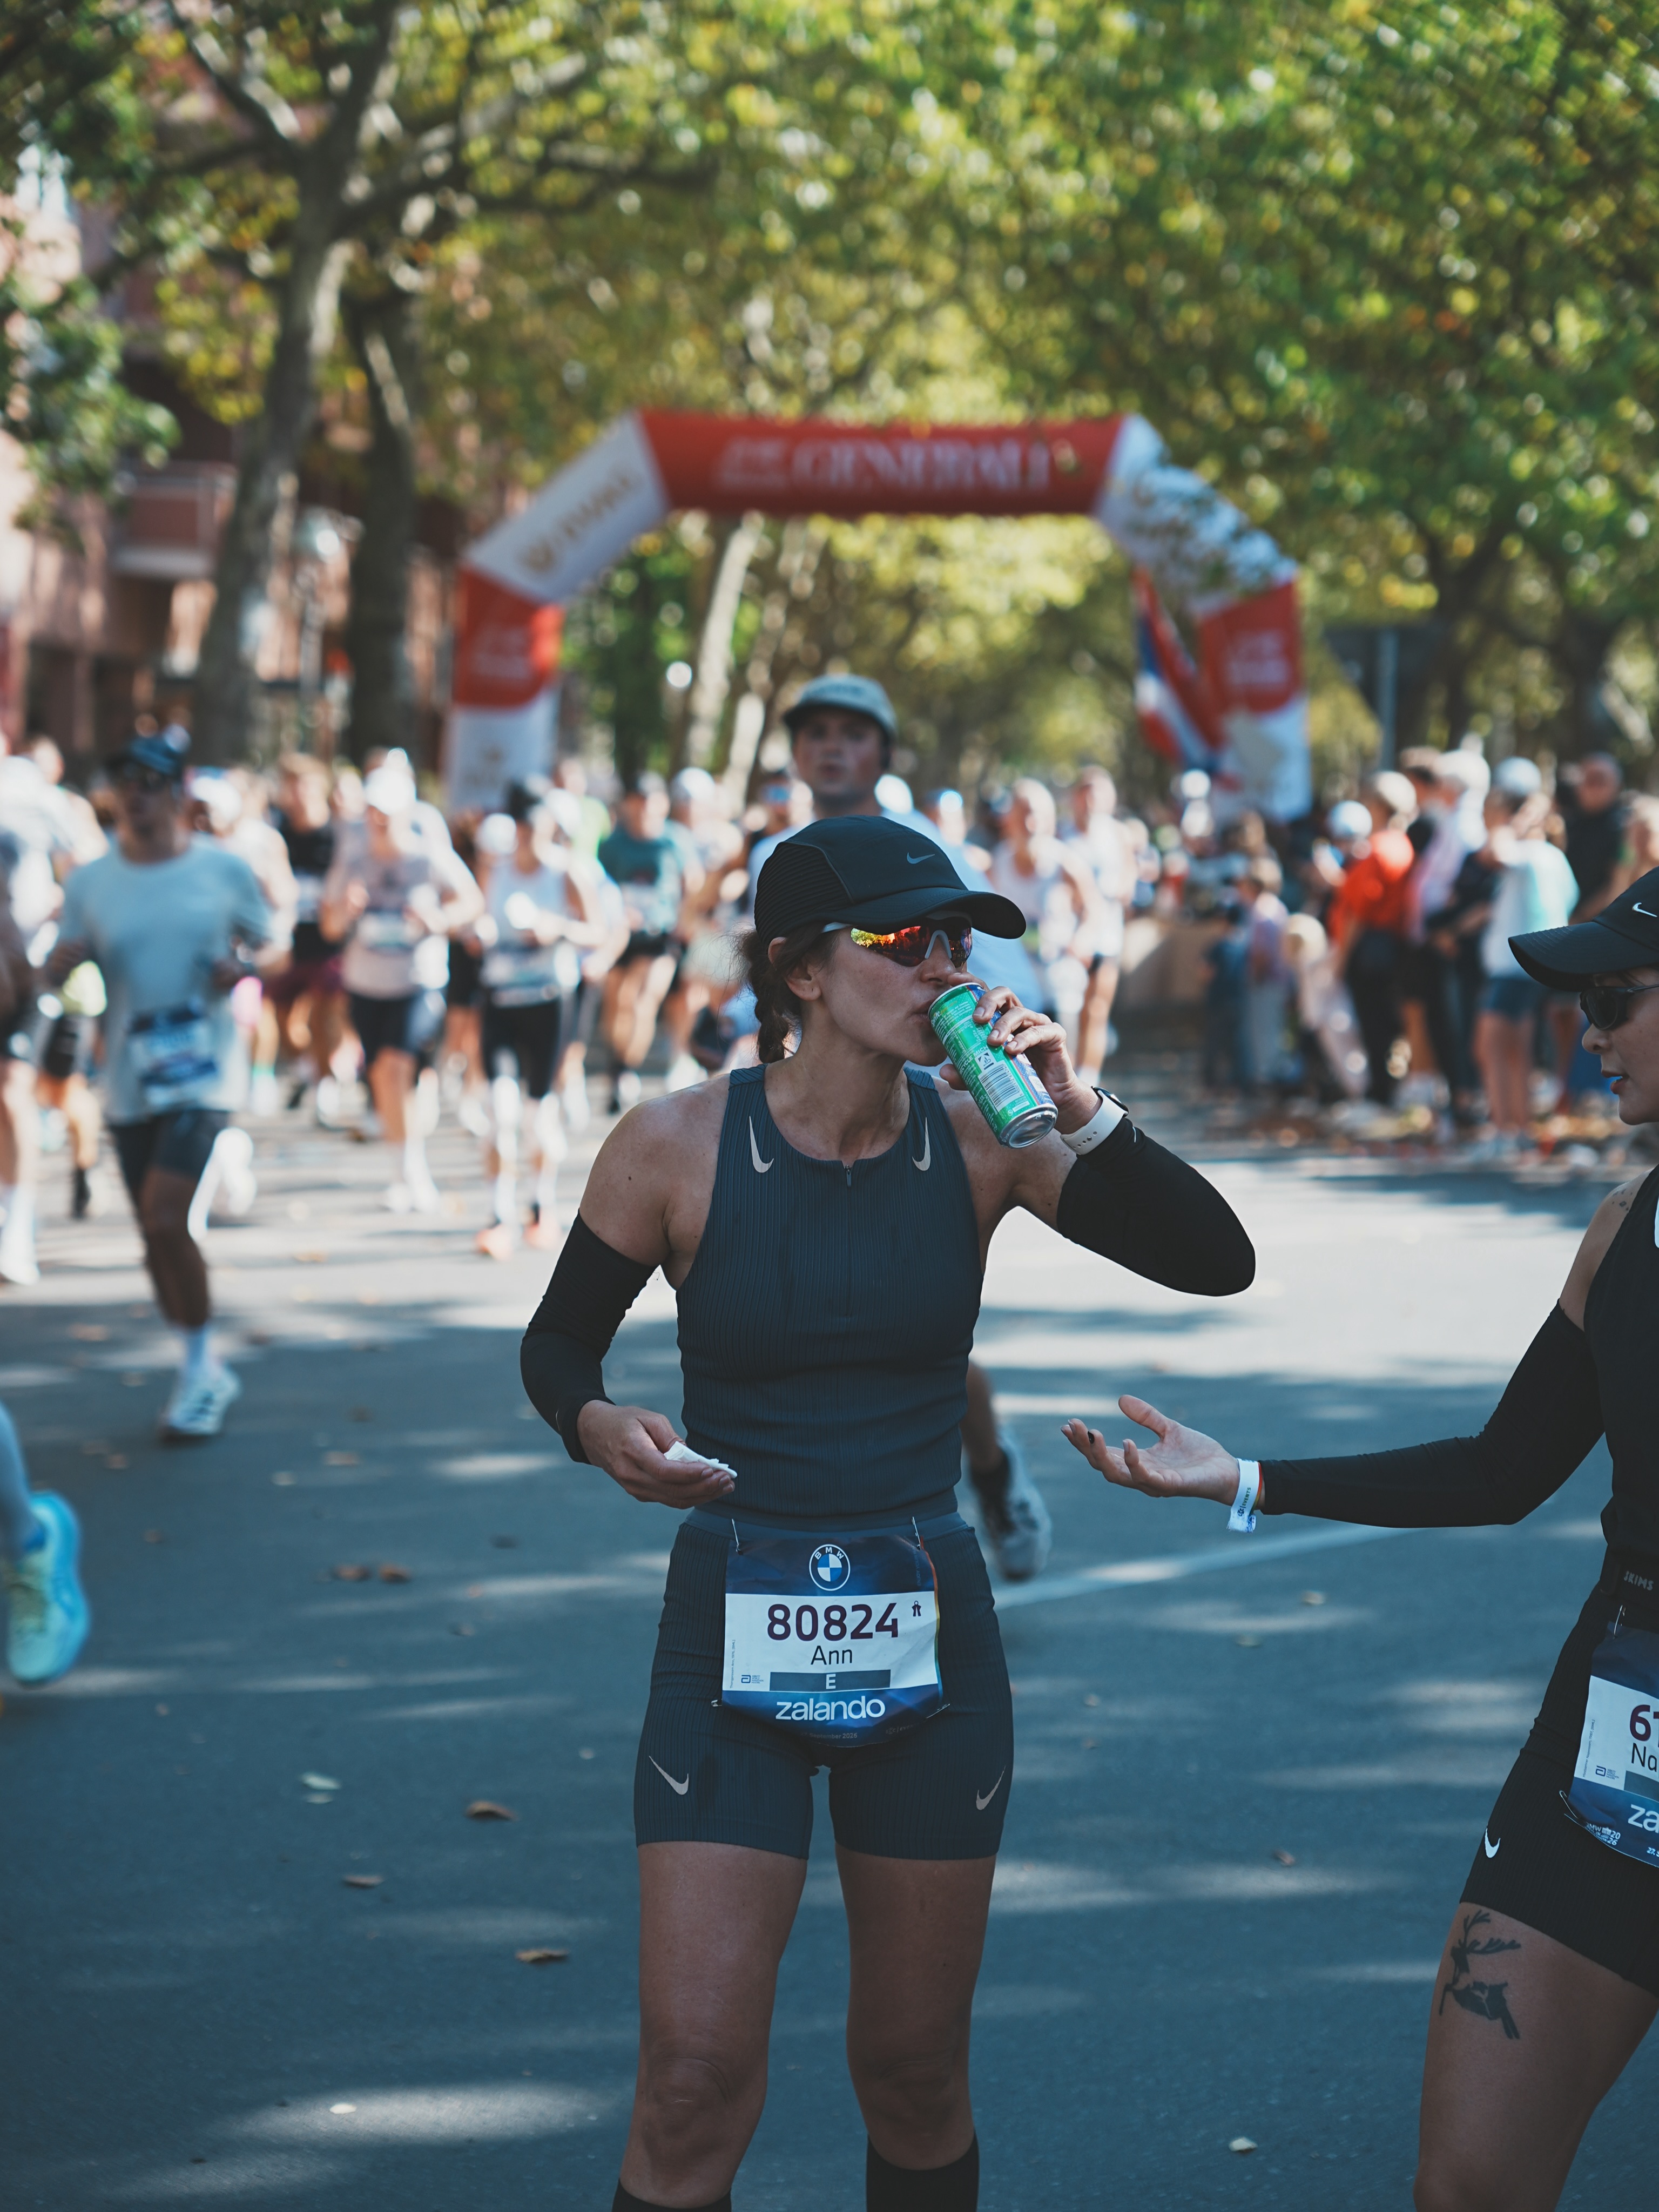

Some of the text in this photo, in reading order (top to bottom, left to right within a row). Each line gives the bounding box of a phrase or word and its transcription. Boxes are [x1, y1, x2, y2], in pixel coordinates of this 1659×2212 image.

[960, 1055, 974, 1075] RECYCLE
[973, 1045, 989, 1057] MICH
[1242, 1487, 1251, 1506] EVENTS
[814, 1547, 844, 1560] BMW
[767, 1602, 898, 1641] 80824
[811, 1645, 853, 1665] Ann
[826, 1674, 836, 1689] E
[775, 1696, 886, 1721] zalando
[1631, 1742, 1657, 1772] Na
[1607, 1837, 1618, 1846] 26
[1610, 1830, 1621, 1840] 20
